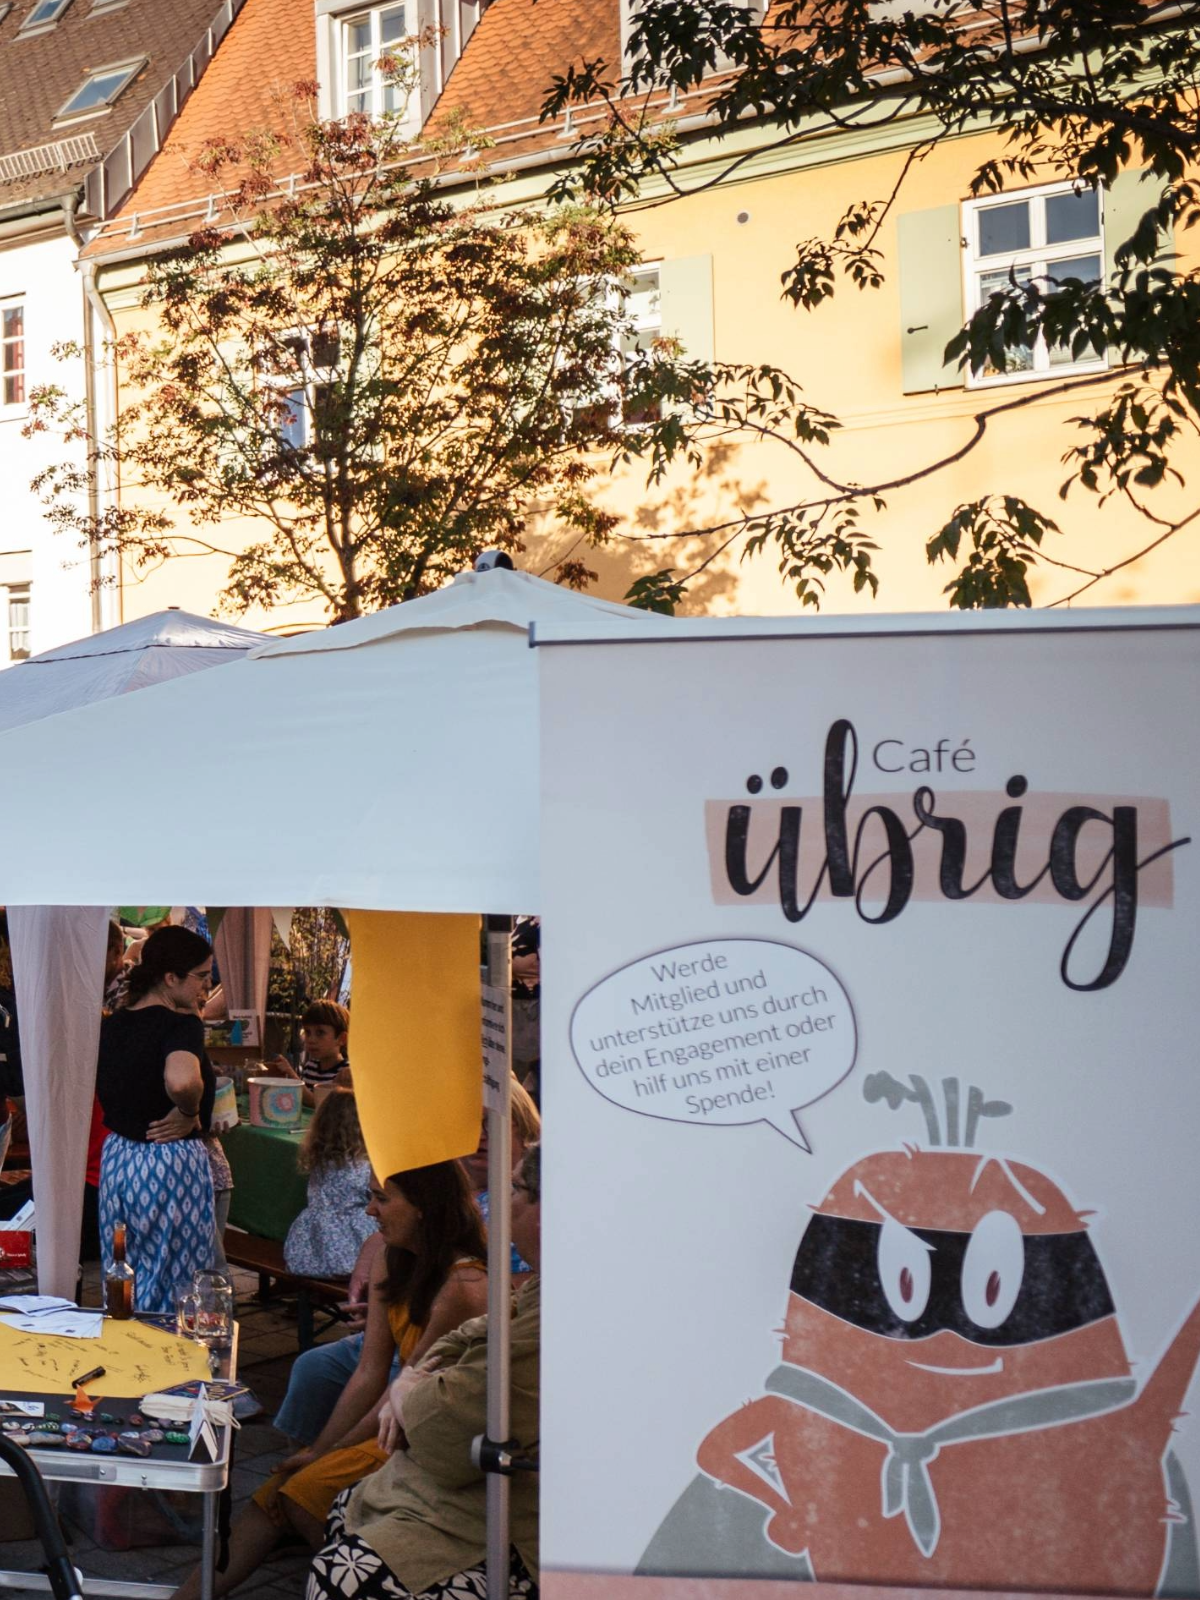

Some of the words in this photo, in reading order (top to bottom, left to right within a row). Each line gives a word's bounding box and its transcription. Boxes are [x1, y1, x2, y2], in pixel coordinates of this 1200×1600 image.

[872, 738, 977, 773] Café
[726, 719, 1191, 992] übrig
[651, 953, 728, 982] Werde
[630, 979, 721, 1016] Mitglied
[724, 969, 768, 996] und
[590, 1012, 715, 1052] unterstütze
[718, 1003, 759, 1025] uns
[762, 986, 828, 1015] durch
[595, 1054, 642, 1078] dein
[644, 1025, 782, 1067] Engagement
[785, 1013, 836, 1038] oder
[633, 1073, 668, 1098] hilf
[672, 1068, 712, 1090] uns
[715, 1058, 751, 1081] mit
[755, 1047, 812, 1073] einer
[685, 1080, 776, 1116] Spende!
